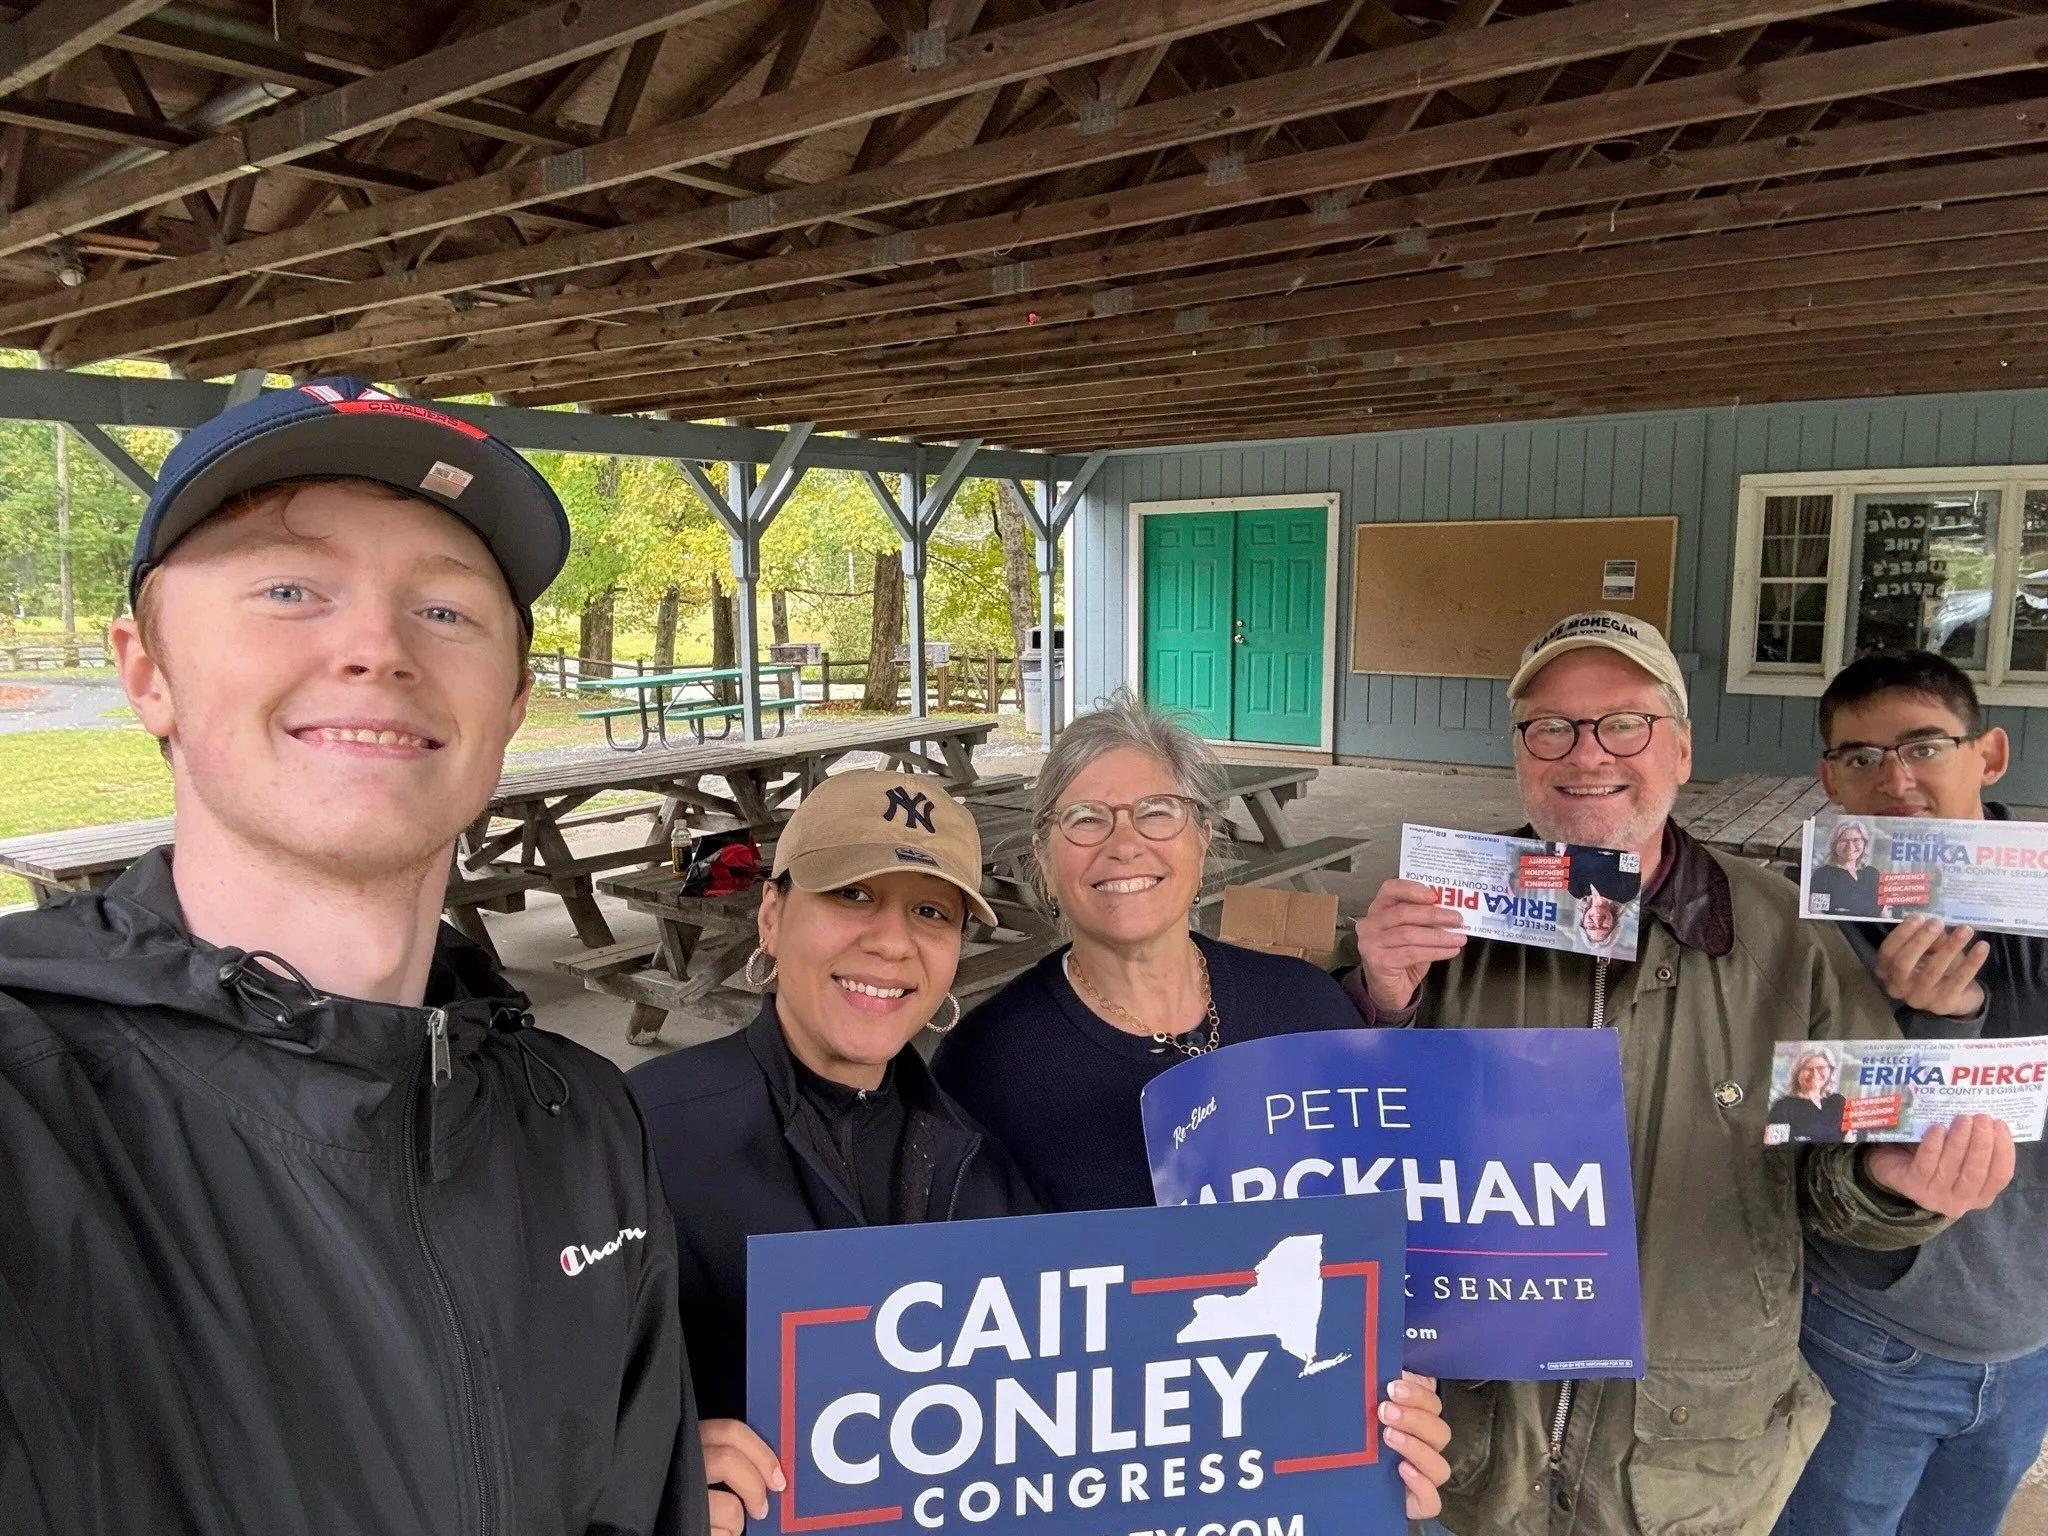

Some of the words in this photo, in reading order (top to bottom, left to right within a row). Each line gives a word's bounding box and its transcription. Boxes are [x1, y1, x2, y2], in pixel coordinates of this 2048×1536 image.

[368, 402, 458, 427] CAVALIERS
[1534, 623, 1565, 653] LAKE
[1567, 617, 1639, 639] MOHEGAN
[883, 785, 936, 834] NY
[1891, 842, 1971, 864] ERIKA
[1405, 872, 1450, 886] LEGISLATOR
[1452, 878, 1488, 891] COUNTY
[1491, 884, 1508, 893] FOR
[1524, 880, 1563, 888] EXPERIENCE
[1484, 893, 1558, 921] ERIKA
[1513, 918, 1556, 932] RE-ELECT
[1862, 1055, 1912, 1065] RE-ELECT
[1859, 1066, 1945, 1085] ERIKA
[1950, 1061, 2048, 1085] PIERCE
[1914, 1086, 1936, 1095] FOR
[1938, 1086, 1984, 1095] COUNTY
[1985, 1083, 2043, 1095] LEGISLATOR
[1172, 1096, 1218, 1150] Re-Elect
[1265, 1087, 1411, 1135] PETE
[1434, 1276, 1596, 1301] SENATE
[875, 1264, 1126, 1374] CAIT
[810, 1351, 1269, 1486] CONLEY
[913, 1448, 1265, 1528] CONGRESS
